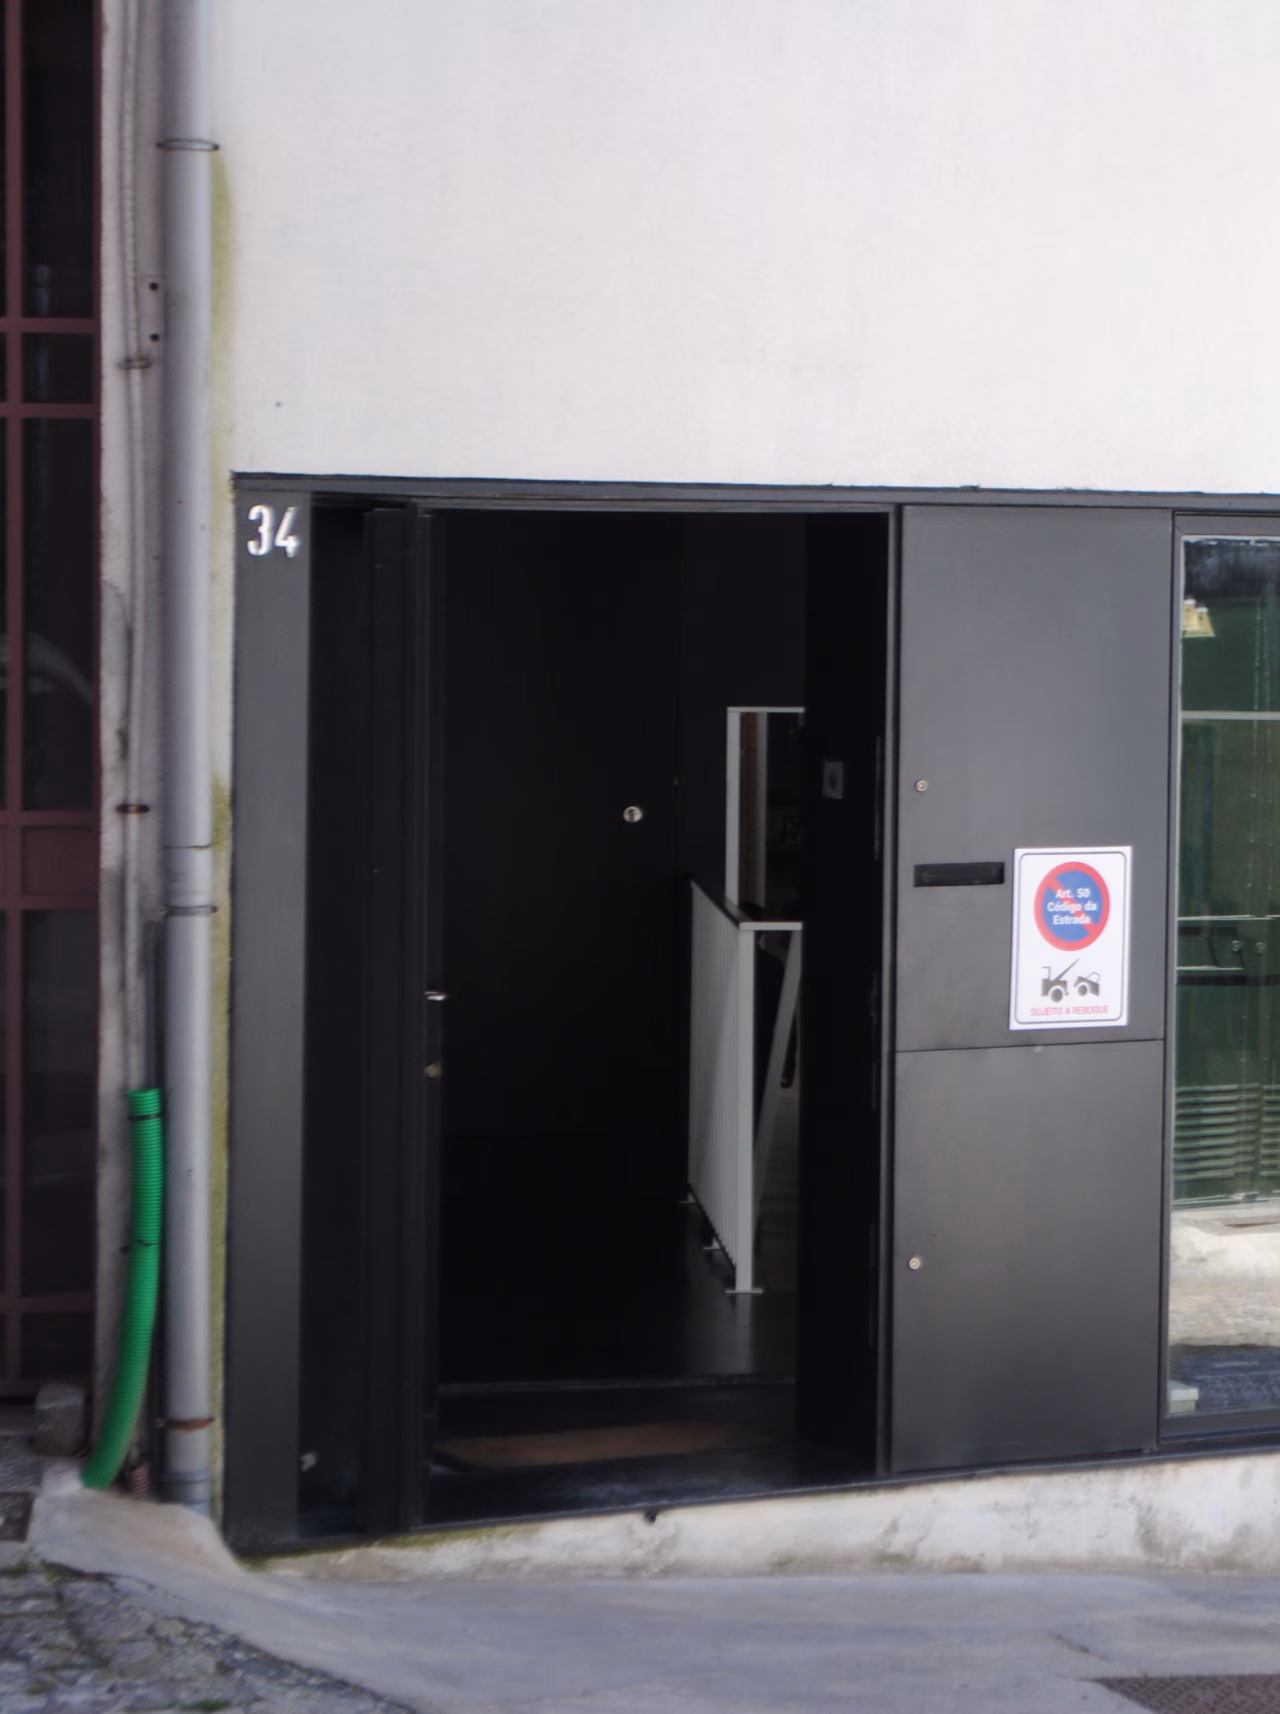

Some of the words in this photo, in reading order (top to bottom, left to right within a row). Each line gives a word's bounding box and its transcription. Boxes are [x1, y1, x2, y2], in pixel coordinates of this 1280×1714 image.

[247, 504, 299, 559] 34
[1055, 888, 1073, 898] Art.
[1077, 887, 1091, 898] 50
[1047, 901, 1082, 913] Código
[1084, 900, 1097, 911] da
[1053, 914, 1091, 925] Estrada
[1030, 1007, 1063, 1016] SUJEITO
[1064, 1007, 1070, 1015] A
[1072, 1005, 1109, 1015] REBOQUE
